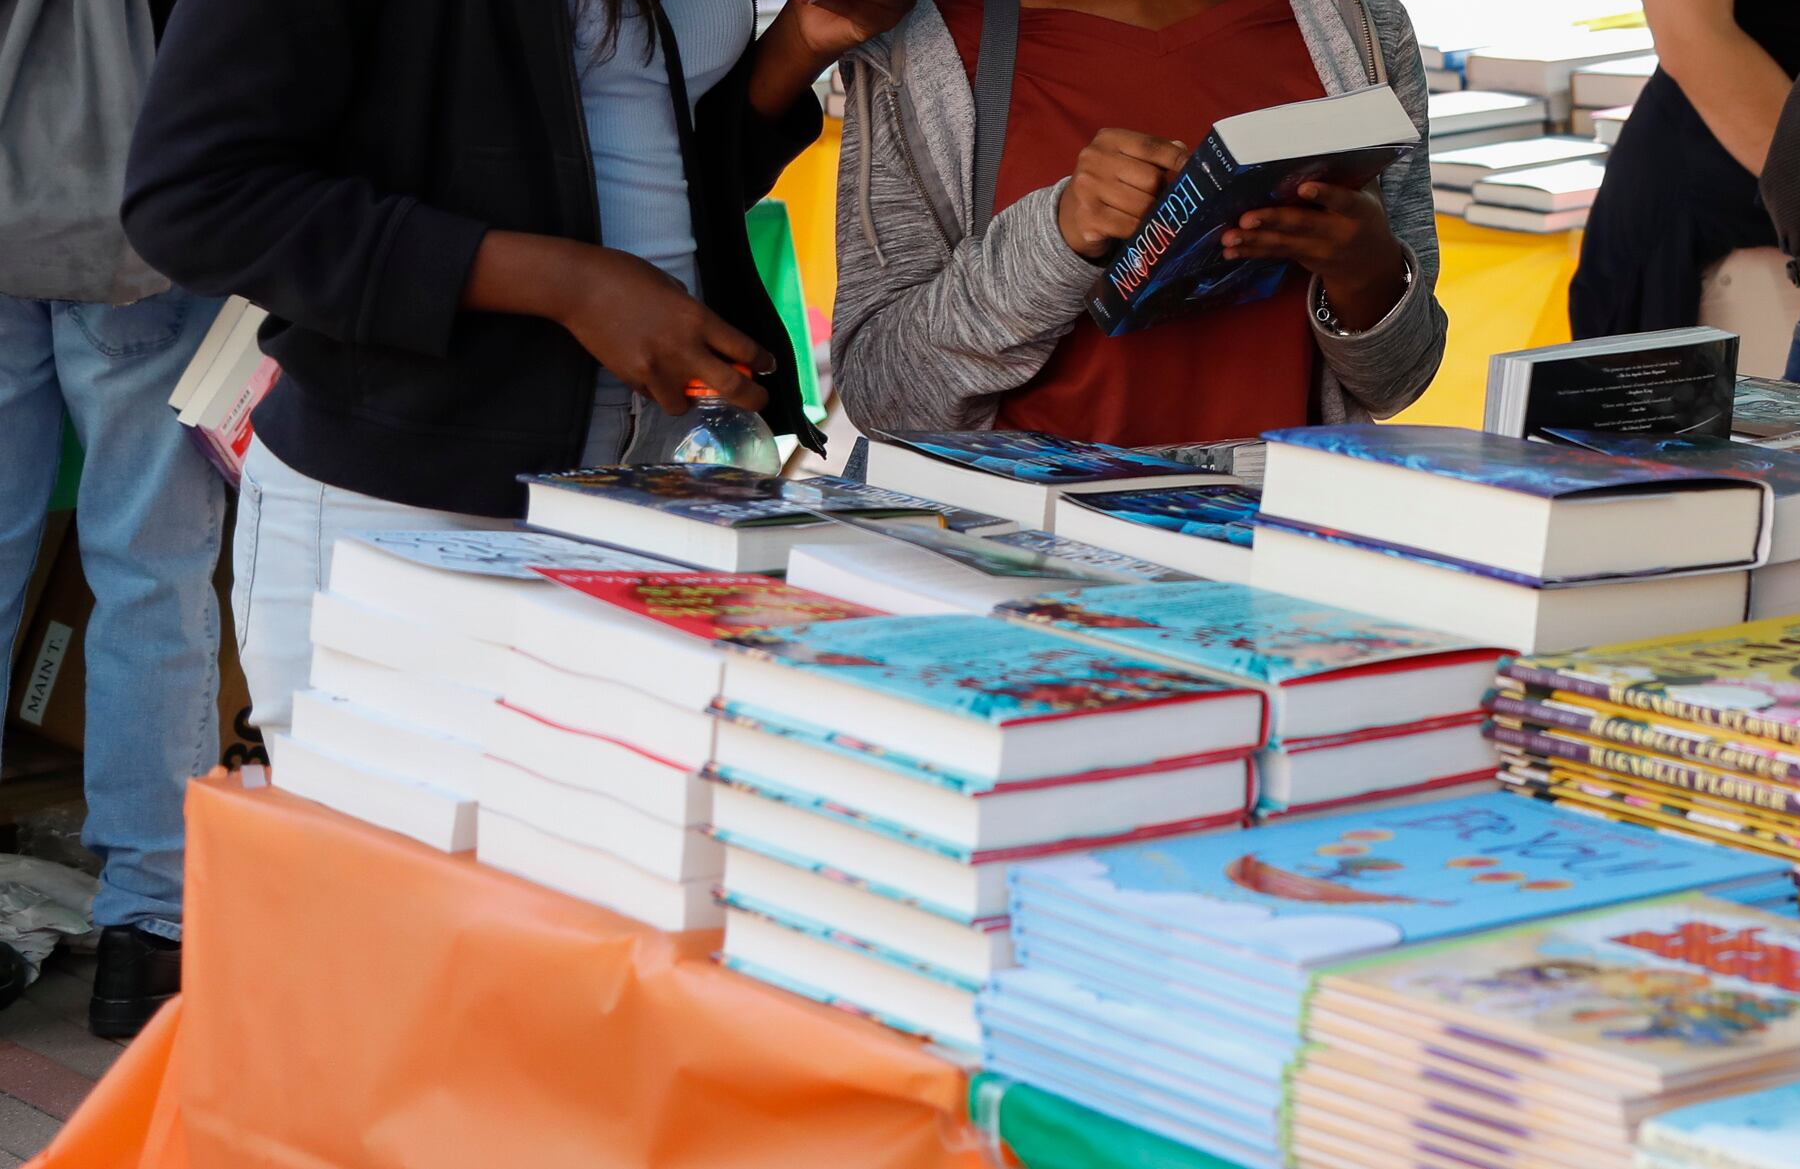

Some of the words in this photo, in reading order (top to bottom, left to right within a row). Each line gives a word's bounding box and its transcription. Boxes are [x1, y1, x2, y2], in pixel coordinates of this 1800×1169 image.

[1207, 135, 1234, 174] DEONN
[1109, 172, 1206, 302] LEGENDBORN
[27, 658, 55, 714] MAIN
[46, 636, 64, 655] T.
[1696, 742, 1788, 777] FLOWER
[1694, 771, 1787, 812] FLOWER
